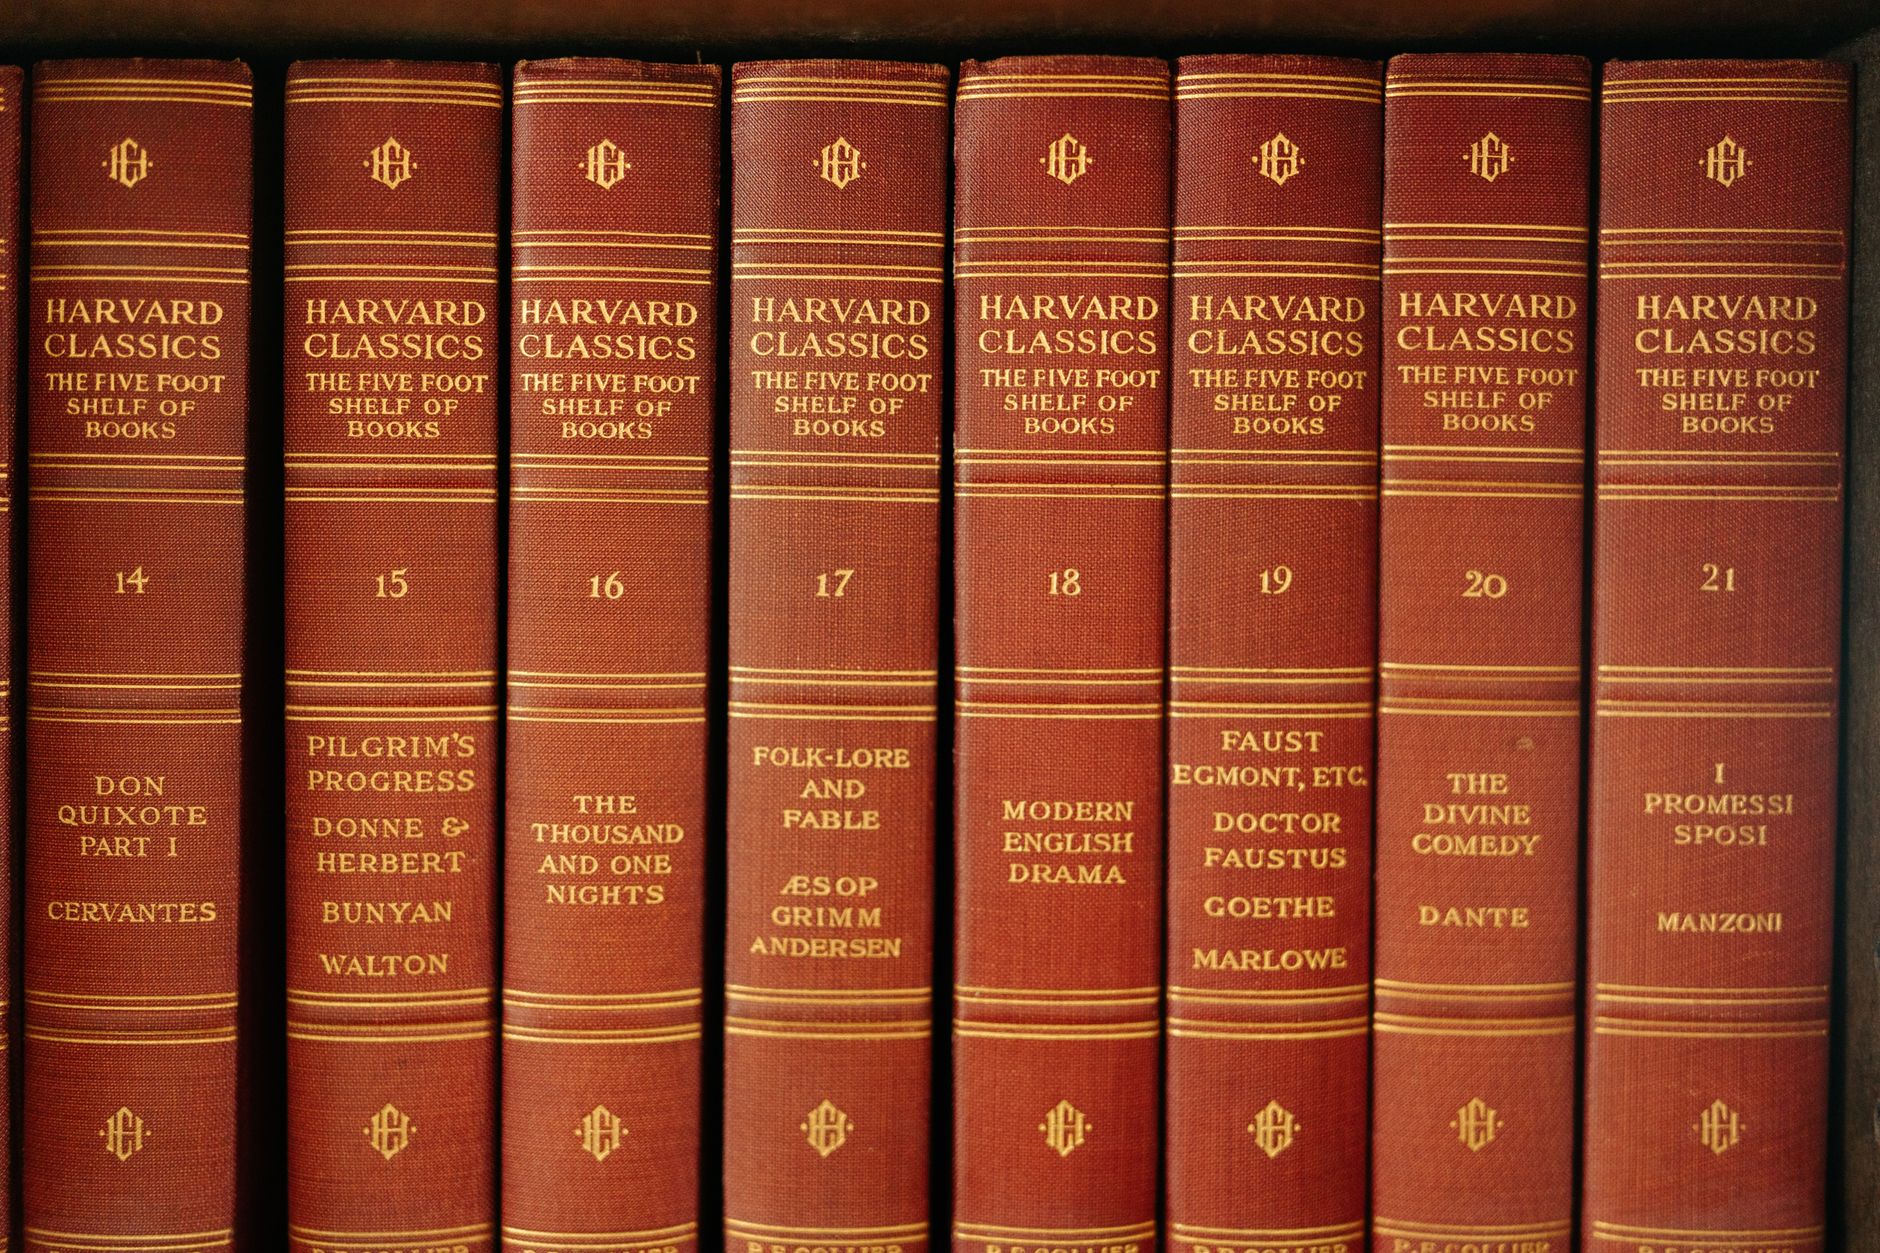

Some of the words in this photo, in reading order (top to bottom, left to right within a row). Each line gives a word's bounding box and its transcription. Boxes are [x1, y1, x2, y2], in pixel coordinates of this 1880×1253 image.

[46, 299, 223, 325] HARVARD
[306, 299, 487, 326] HARVARD
[518, 299, 698, 327] HARVARD
[752, 297, 931, 325] HARVARD
[981, 295, 1158, 320] HARVARD
[1188, 294, 1365, 322] HARVARD
[1400, 292, 1576, 319] HARVARD
[1637, 295, 1817, 320] HARVARD
[44, 334, 220, 359] CLASSICS
[303, 333, 483, 361] CLASSICS
[518, 334, 696, 361] CLASSICS
[750, 332, 928, 360] CLASSICS
[979, 330, 1156, 354] CLASSICS
[1187, 330, 1363, 357] CLASSICS
[1397, 326, 1573, 353] CLASSICS
[1636, 329, 1815, 354] CLASSICS
[45, 373, 87, 391] THE
[95, 373, 149, 391] FIVE
[157, 374, 225, 393] FOOT
[305, 372, 351, 392] THE
[359, 373, 413, 391] FIVE
[421, 374, 489, 393] FOOT
[520, 373, 563, 392] THE
[571, 374, 626, 392] FIVE
[633, 375, 701, 395] FOOT
[751, 371, 798, 389] THE
[805, 371, 859, 390] FIVE
[867, 373, 932, 393] FOOT
[980, 369, 1026, 387] THE
[1034, 369, 1089, 387] FIVE
[1096, 369, 1160, 388] FOOT
[1189, 369, 1238, 388] THE
[1245, 369, 1300, 388] FIVE
[1307, 370, 1366, 389] FOOT
[1398, 365, 1447, 384] THE
[1455, 366, 1509, 385] FIVE
[1517, 368, 1578, 386] FOOT
[1636, 368, 1686, 387] THE
[1694, 369, 1749, 387] FIVE
[1756, 370, 1820, 388] FOOT
[67, 398, 147, 415] SHELF
[159, 400, 195, 416] OF
[329, 398, 410, 415] SHELF
[424, 399, 458, 415] OF
[542, 399, 623, 416] SHELF
[636, 400, 672, 417] OF
[775, 396, 856, 414] SHELF
[870, 398, 904, 415] OF
[1004, 394, 1086, 411] SHELF
[1098, 396, 1134, 412] OF
[1214, 394, 1296, 411] SHELF
[1309, 395, 1341, 412] OF
[1424, 391, 1506, 408] SHELF
[1519, 392, 1552, 409] OF
[1662, 393, 1746, 411] SHELF
[1759, 394, 1792, 412] OF
[86, 421, 176, 438] BOOKS
[348, 421, 440, 438] BOOKS
[562, 422, 652, 439] BOOKS
[794, 419, 885, 437] BOOKS
[1025, 417, 1114, 434] BOOKS
[1233, 417, 1325, 434] BOOKS
[1443, 414, 1535, 431] BOOKS
[1683, 416, 1774, 433] BOOKS
[115, 566, 149, 593] 14
[376, 568, 408, 598] 15
[590, 571, 624, 600] 16
[816, 569, 854, 597] 17
[1049, 568, 1081, 596] 18
[1260, 565, 1292, 594] 19
[1462, 570, 1507, 598] 20
[1701, 564, 1734, 591] 21
[307, 732, 475, 757] PILGRIM'S
[1221, 731, 1323, 752] FAUST
[753, 747, 910, 768] FOLK-LORE
[308, 770, 475, 792] PROGRESS
[1172, 763, 1305, 792] EGMONT,
[1313, 766, 1367, 787] ETC.
[1447, 773, 1508, 794] THE
[1715, 763, 1724, 784] I
[95, 776, 165, 795] DON
[800, 779, 865, 799] AND
[573, 795, 636, 814] THE
[1003, 800, 1134, 821] MODERN
[1424, 804, 1530, 824] DIVINE
[1645, 793, 1792, 814] PROMESSI
[58, 805, 207, 826] QUIXOTE
[783, 809, 880, 830] FABLE
[1213, 812, 1341, 833] DOCTOR
[313, 817, 423, 838] DONNE
[442, 817, 469, 837] &
[531, 823, 684, 844] THOUSAND
[1675, 825, 1766, 845] SPOSI
[81, 836, 150, 856] PART
[168, 837, 177, 857] I
[1003, 832, 1134, 853] ENGLISH
[1412, 834, 1540, 855] COMEDY
[317, 851, 465, 873] HERBERT
[538, 855, 598, 874] AND
[611, 855, 672, 874] ONE
[1204, 848, 1347, 869] FAUSTUS
[1008, 863, 1126, 884] DRAMA
[547, 885, 664, 905] NIGHTS
[781, 876, 878, 896] ÆSOP
[48, 902, 216, 922] CERVANTES
[322, 901, 451, 923] BUNYAN
[772, 906, 881, 927] GRIMM
[1204, 896, 1335, 918] GOETHE
[1420, 906, 1529, 927] DANTE
[1658, 912, 1782, 932] MANZONI
[750, 937, 901, 958] ANDERSEN
[319, 954, 448, 976] WALTON
[1193, 947, 1347, 970] MARLOWE
